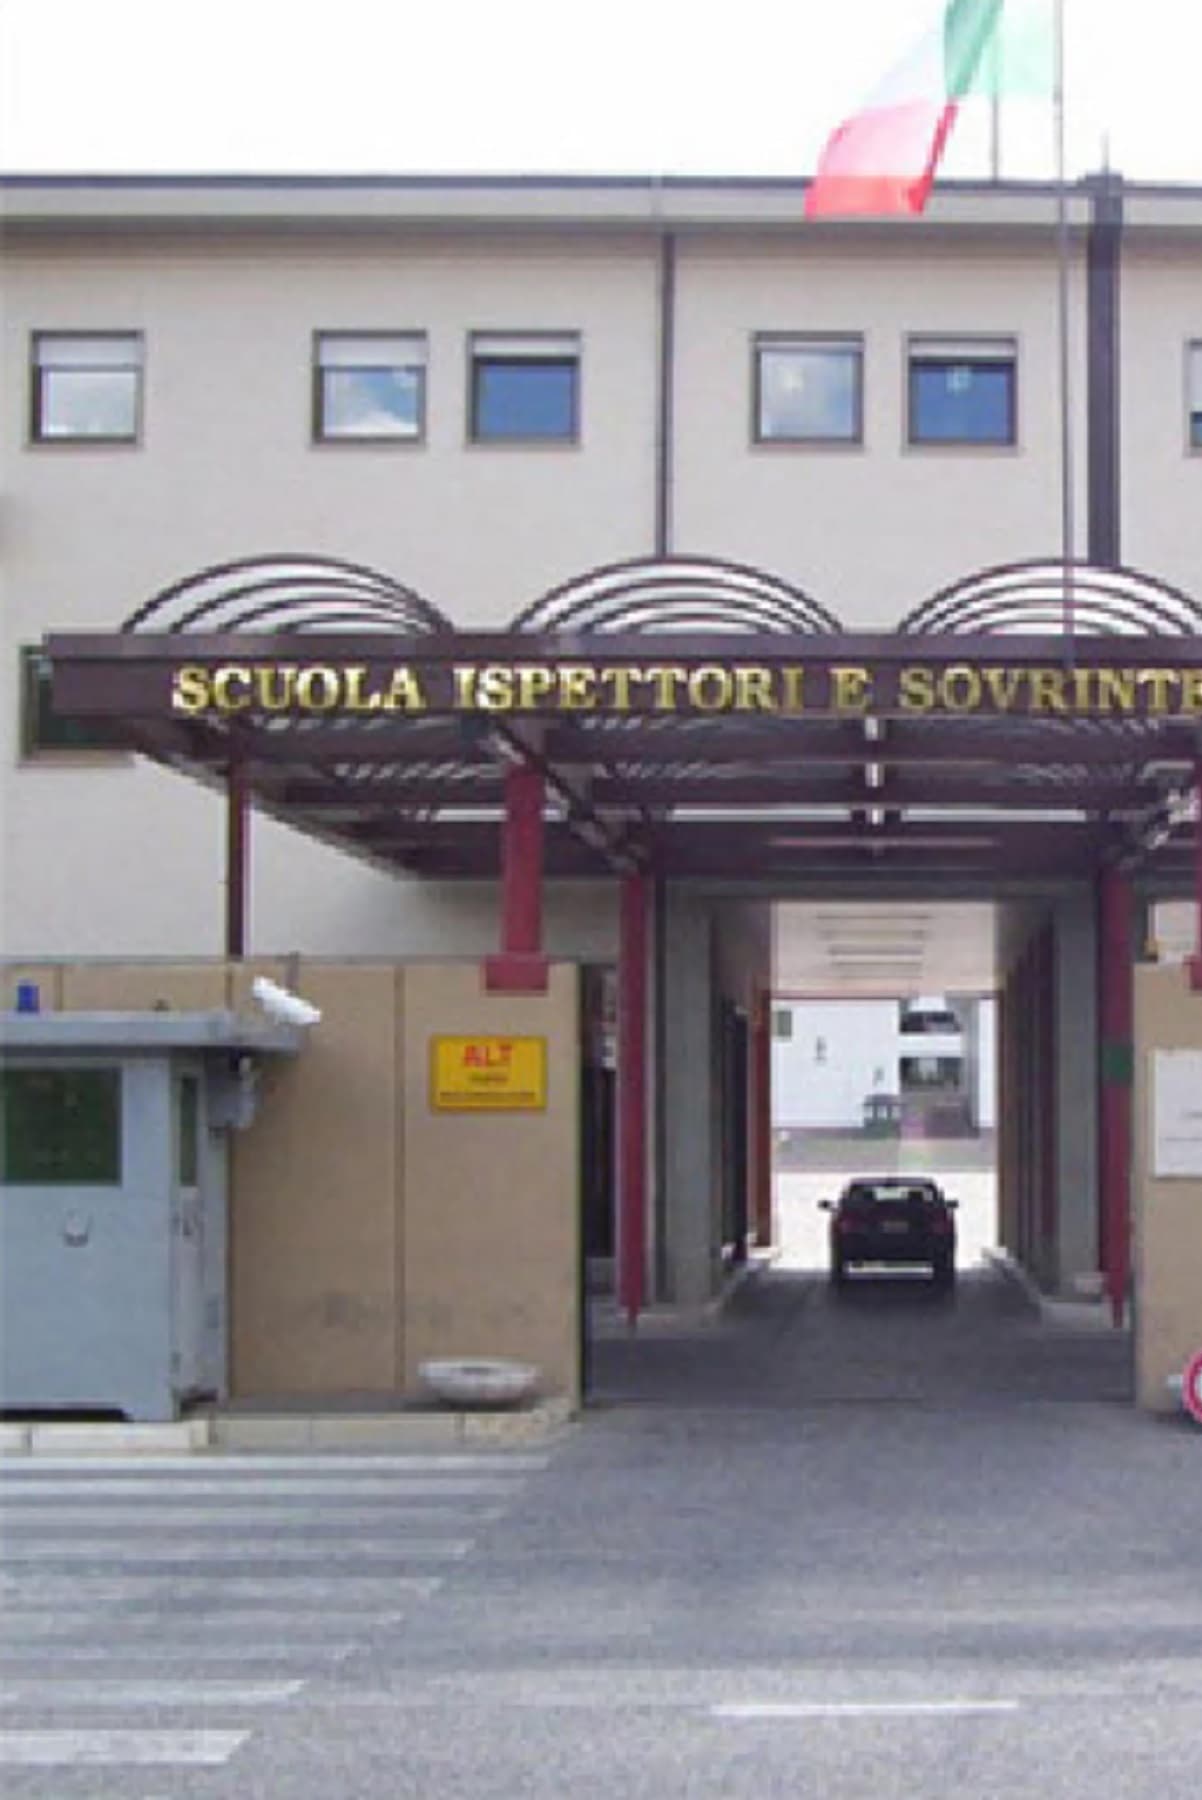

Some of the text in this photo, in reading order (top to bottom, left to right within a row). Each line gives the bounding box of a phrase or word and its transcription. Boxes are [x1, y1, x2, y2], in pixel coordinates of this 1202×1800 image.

[172, 666, 421, 713] SCUOLA
[453, 666, 804, 713] ISPETTORI
[829, 666, 872, 713] E
